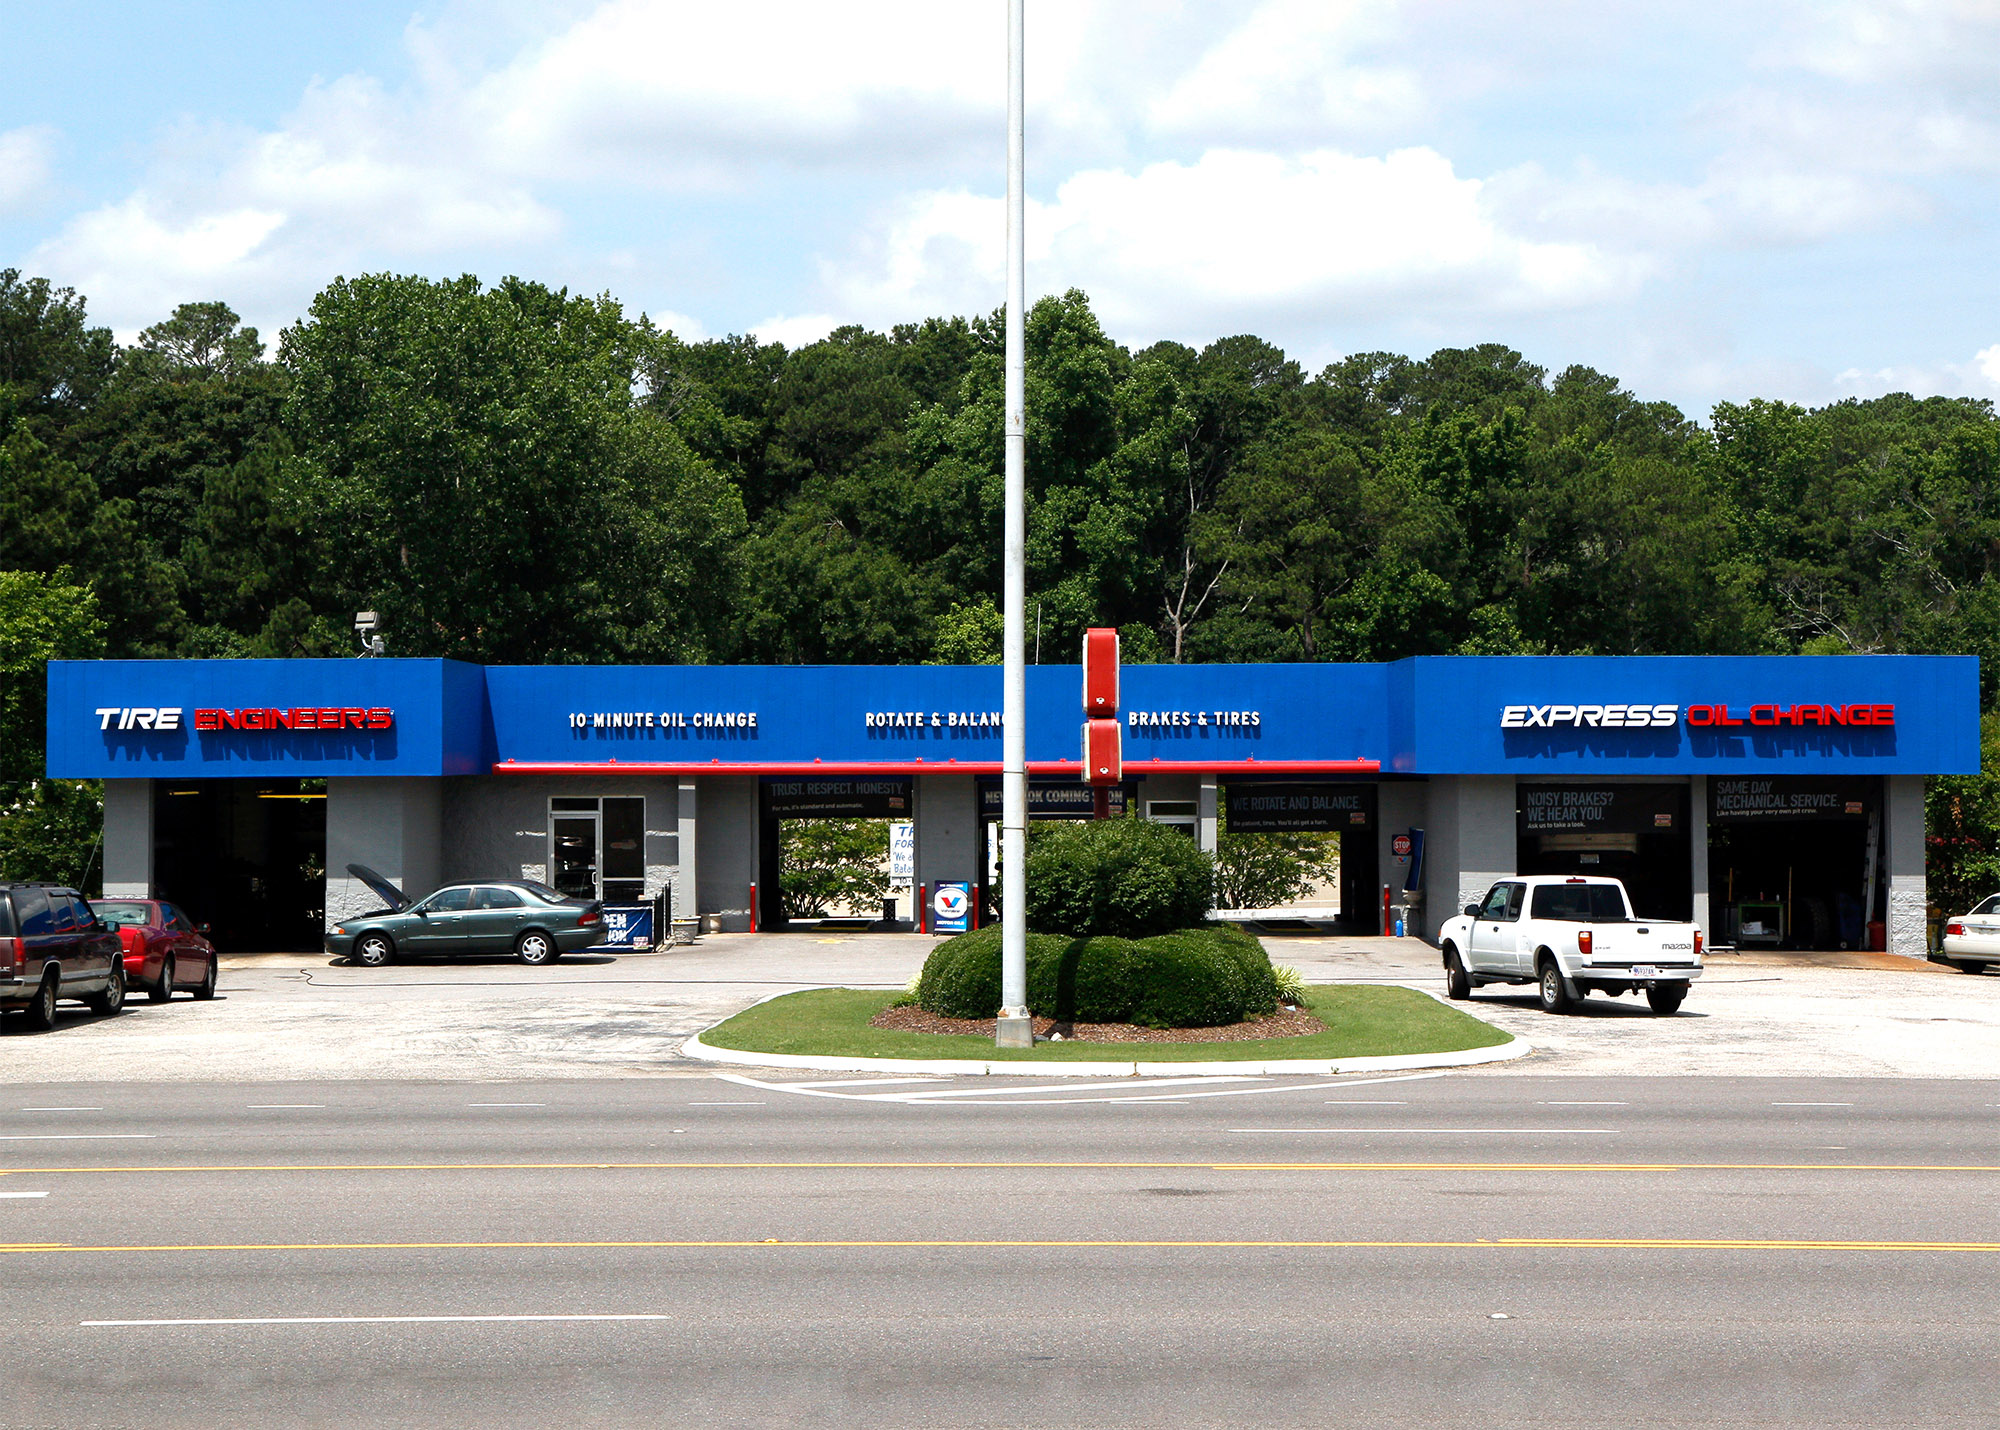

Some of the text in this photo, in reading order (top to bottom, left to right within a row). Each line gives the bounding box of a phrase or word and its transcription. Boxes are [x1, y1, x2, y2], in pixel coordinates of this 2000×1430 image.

[95, 707, 392, 730] TIRE ENGINEERS
[569, 712, 757, 728] 10 MINUTE OIL CHANGE
[866, 712, 1004, 727] ROTATE & BALAN
[1129, 711, 1260, 726] BRAKES & TIRES
[1500, 704, 1894, 728] EXPRESS OIL CHANGE
[771, 782, 905, 797] TRUST. RESPECT. HONESTY.
[1717, 780, 1773, 796] SAME DAY
[985, 791, 1003, 804] NE
[1045, 789, 1090, 803] COMING
[1232, 795, 1361, 811] WE ROTATE AND BALANCE.
[1527, 791, 1614, 806] NOISY BRAKES?
[1716, 794, 1787, 810] MECHANICAL
[1790, 793, 1841, 808] SERVICE.
[1527, 806, 1605, 822] WE HEAR YOU.
[1729, 809, 1749, 817] having
[1764, 809, 1777, 817] very
[1792, 808, 1801, 816] pit
[1395, 841, 1410, 849] STOP
